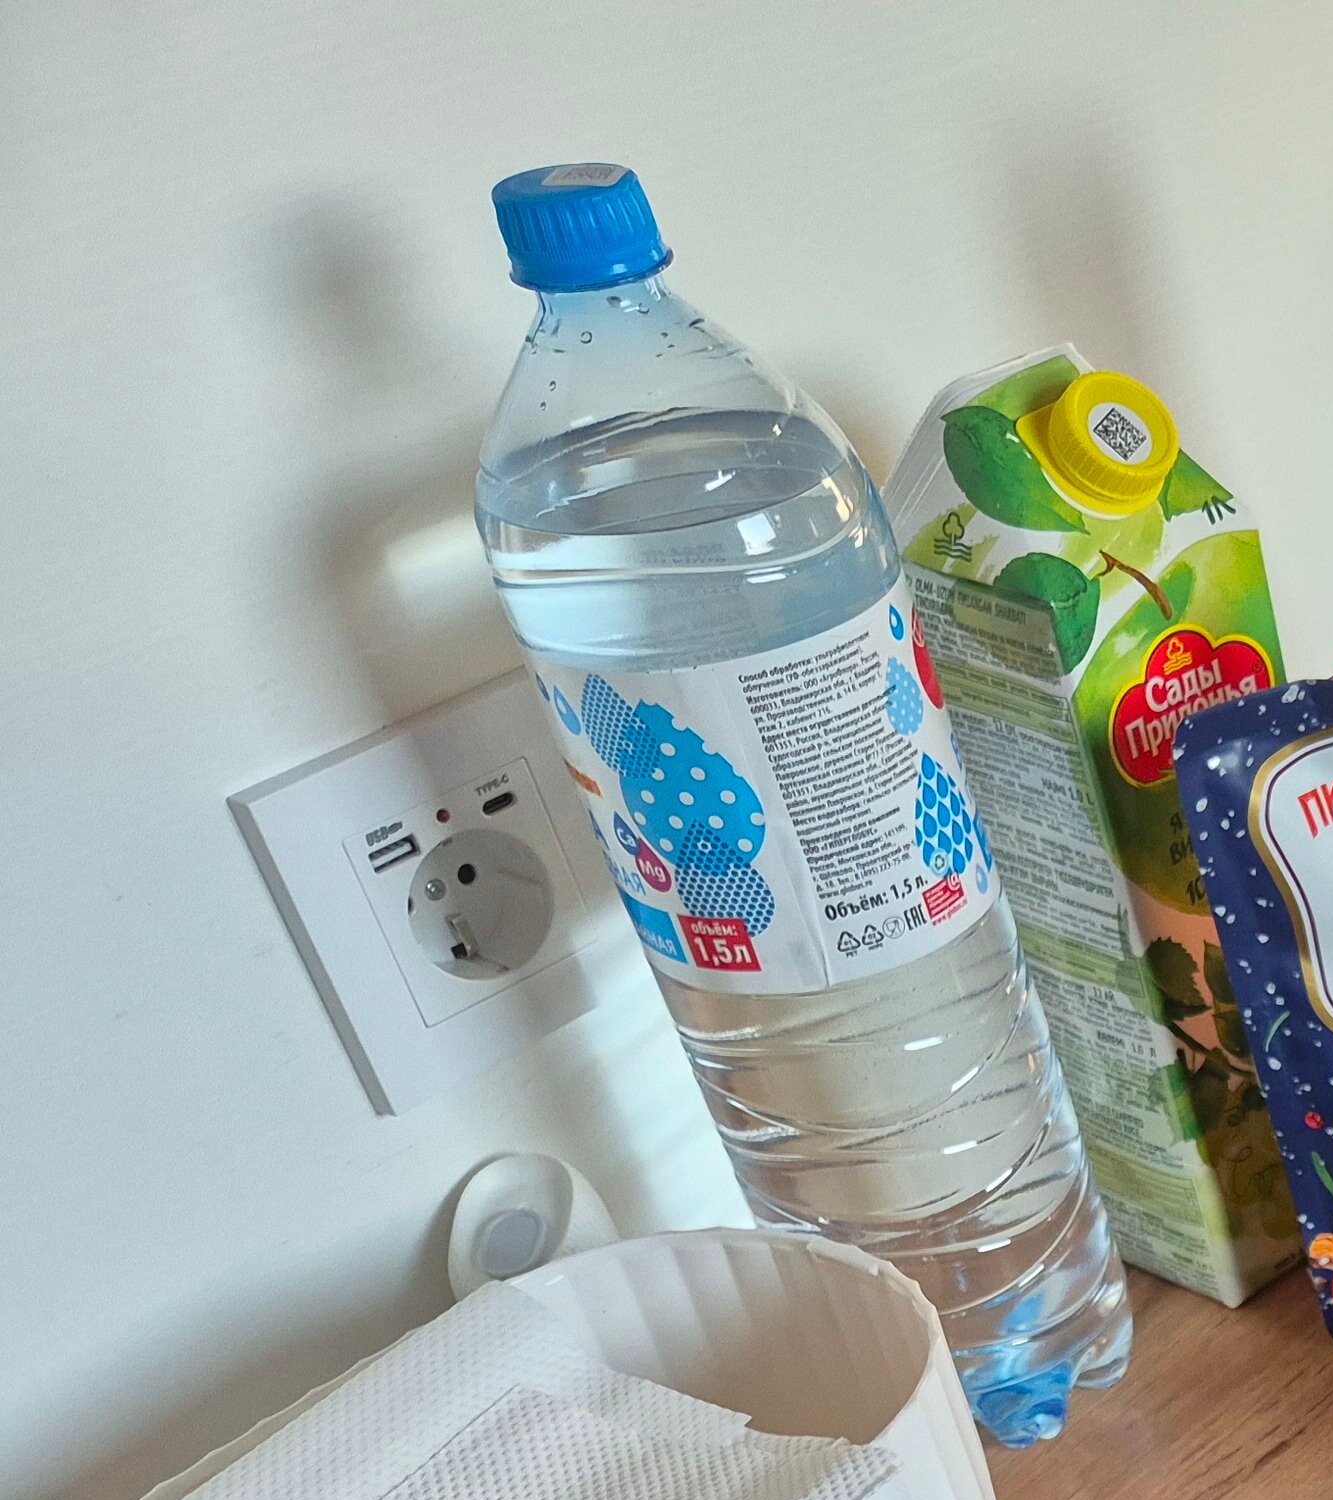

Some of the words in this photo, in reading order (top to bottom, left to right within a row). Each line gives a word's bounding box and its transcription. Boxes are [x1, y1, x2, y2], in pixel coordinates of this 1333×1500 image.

[738, 669, 769, 684] Способ
[803, 678, 818, 689] ООО
[1145, 658, 1223, 713] Сады
[761, 731, 787, 745] Адрес
[786, 724, 809, 738] места
[764, 741, 796, 754] 601351,
[797, 733, 823, 747] Россия,
[474, 774, 510, 797] TYPE-C
[793, 813, 817, 827] Место
[638, 858, 667, 884] Mg
[824, 894, 889, 921] Объём:
[890, 877, 912, 899] 1,5
[915, 875, 928, 890] л.
[690, 920, 738, 937] объём:
